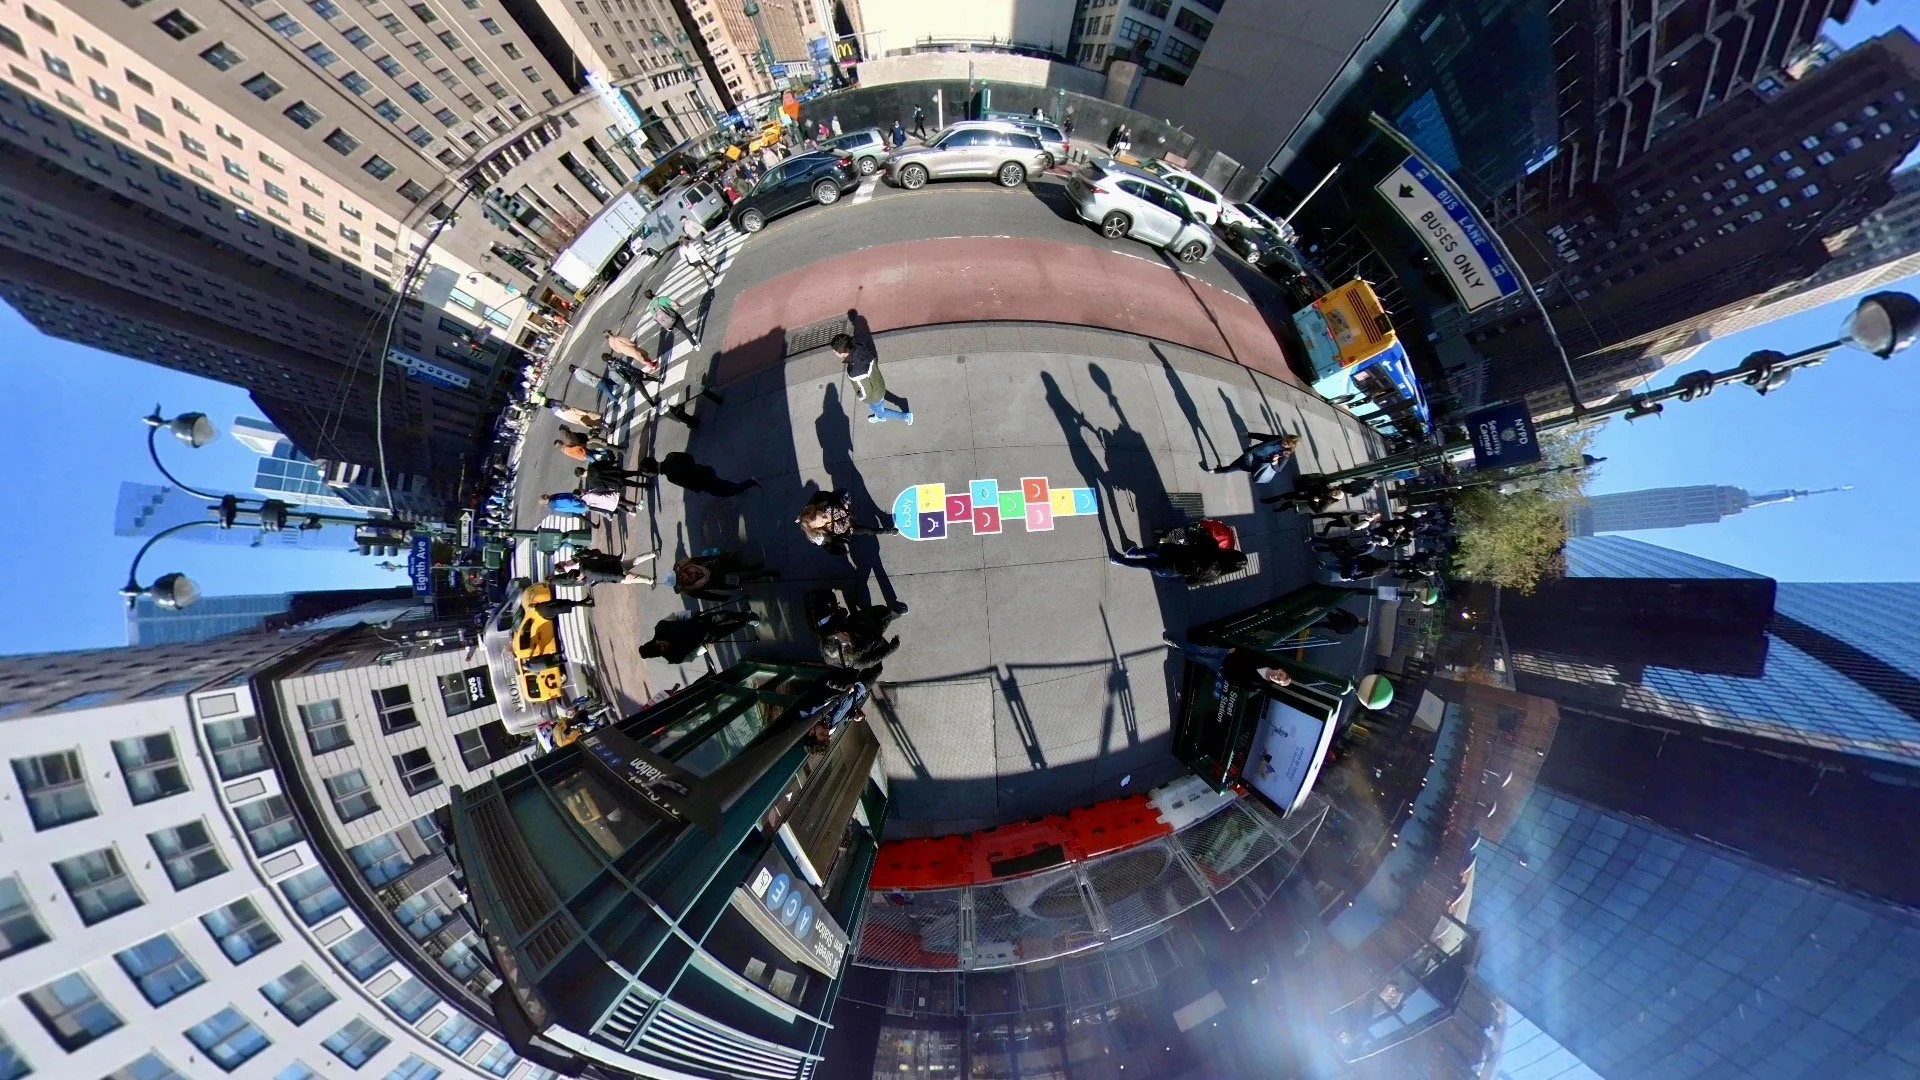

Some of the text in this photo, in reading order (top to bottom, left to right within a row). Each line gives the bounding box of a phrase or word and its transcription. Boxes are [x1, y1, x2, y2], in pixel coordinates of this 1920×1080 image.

[1436, 190, 1486, 246] BUS LANE
[1420, 211, 1485, 289] BUSES ONLY
[1480, 424, 1493, 456] Camera
[1488, 420, 1500, 455] Security
[1514, 418, 1528, 444] NYPD
[415, 541, 428, 590] Eighth Ave
[468, 676, 480, 694] CVS
[1216, 694, 1229, 723] Station
[772, 880, 810, 931] A C E
[815, 918, 834, 948] Station
